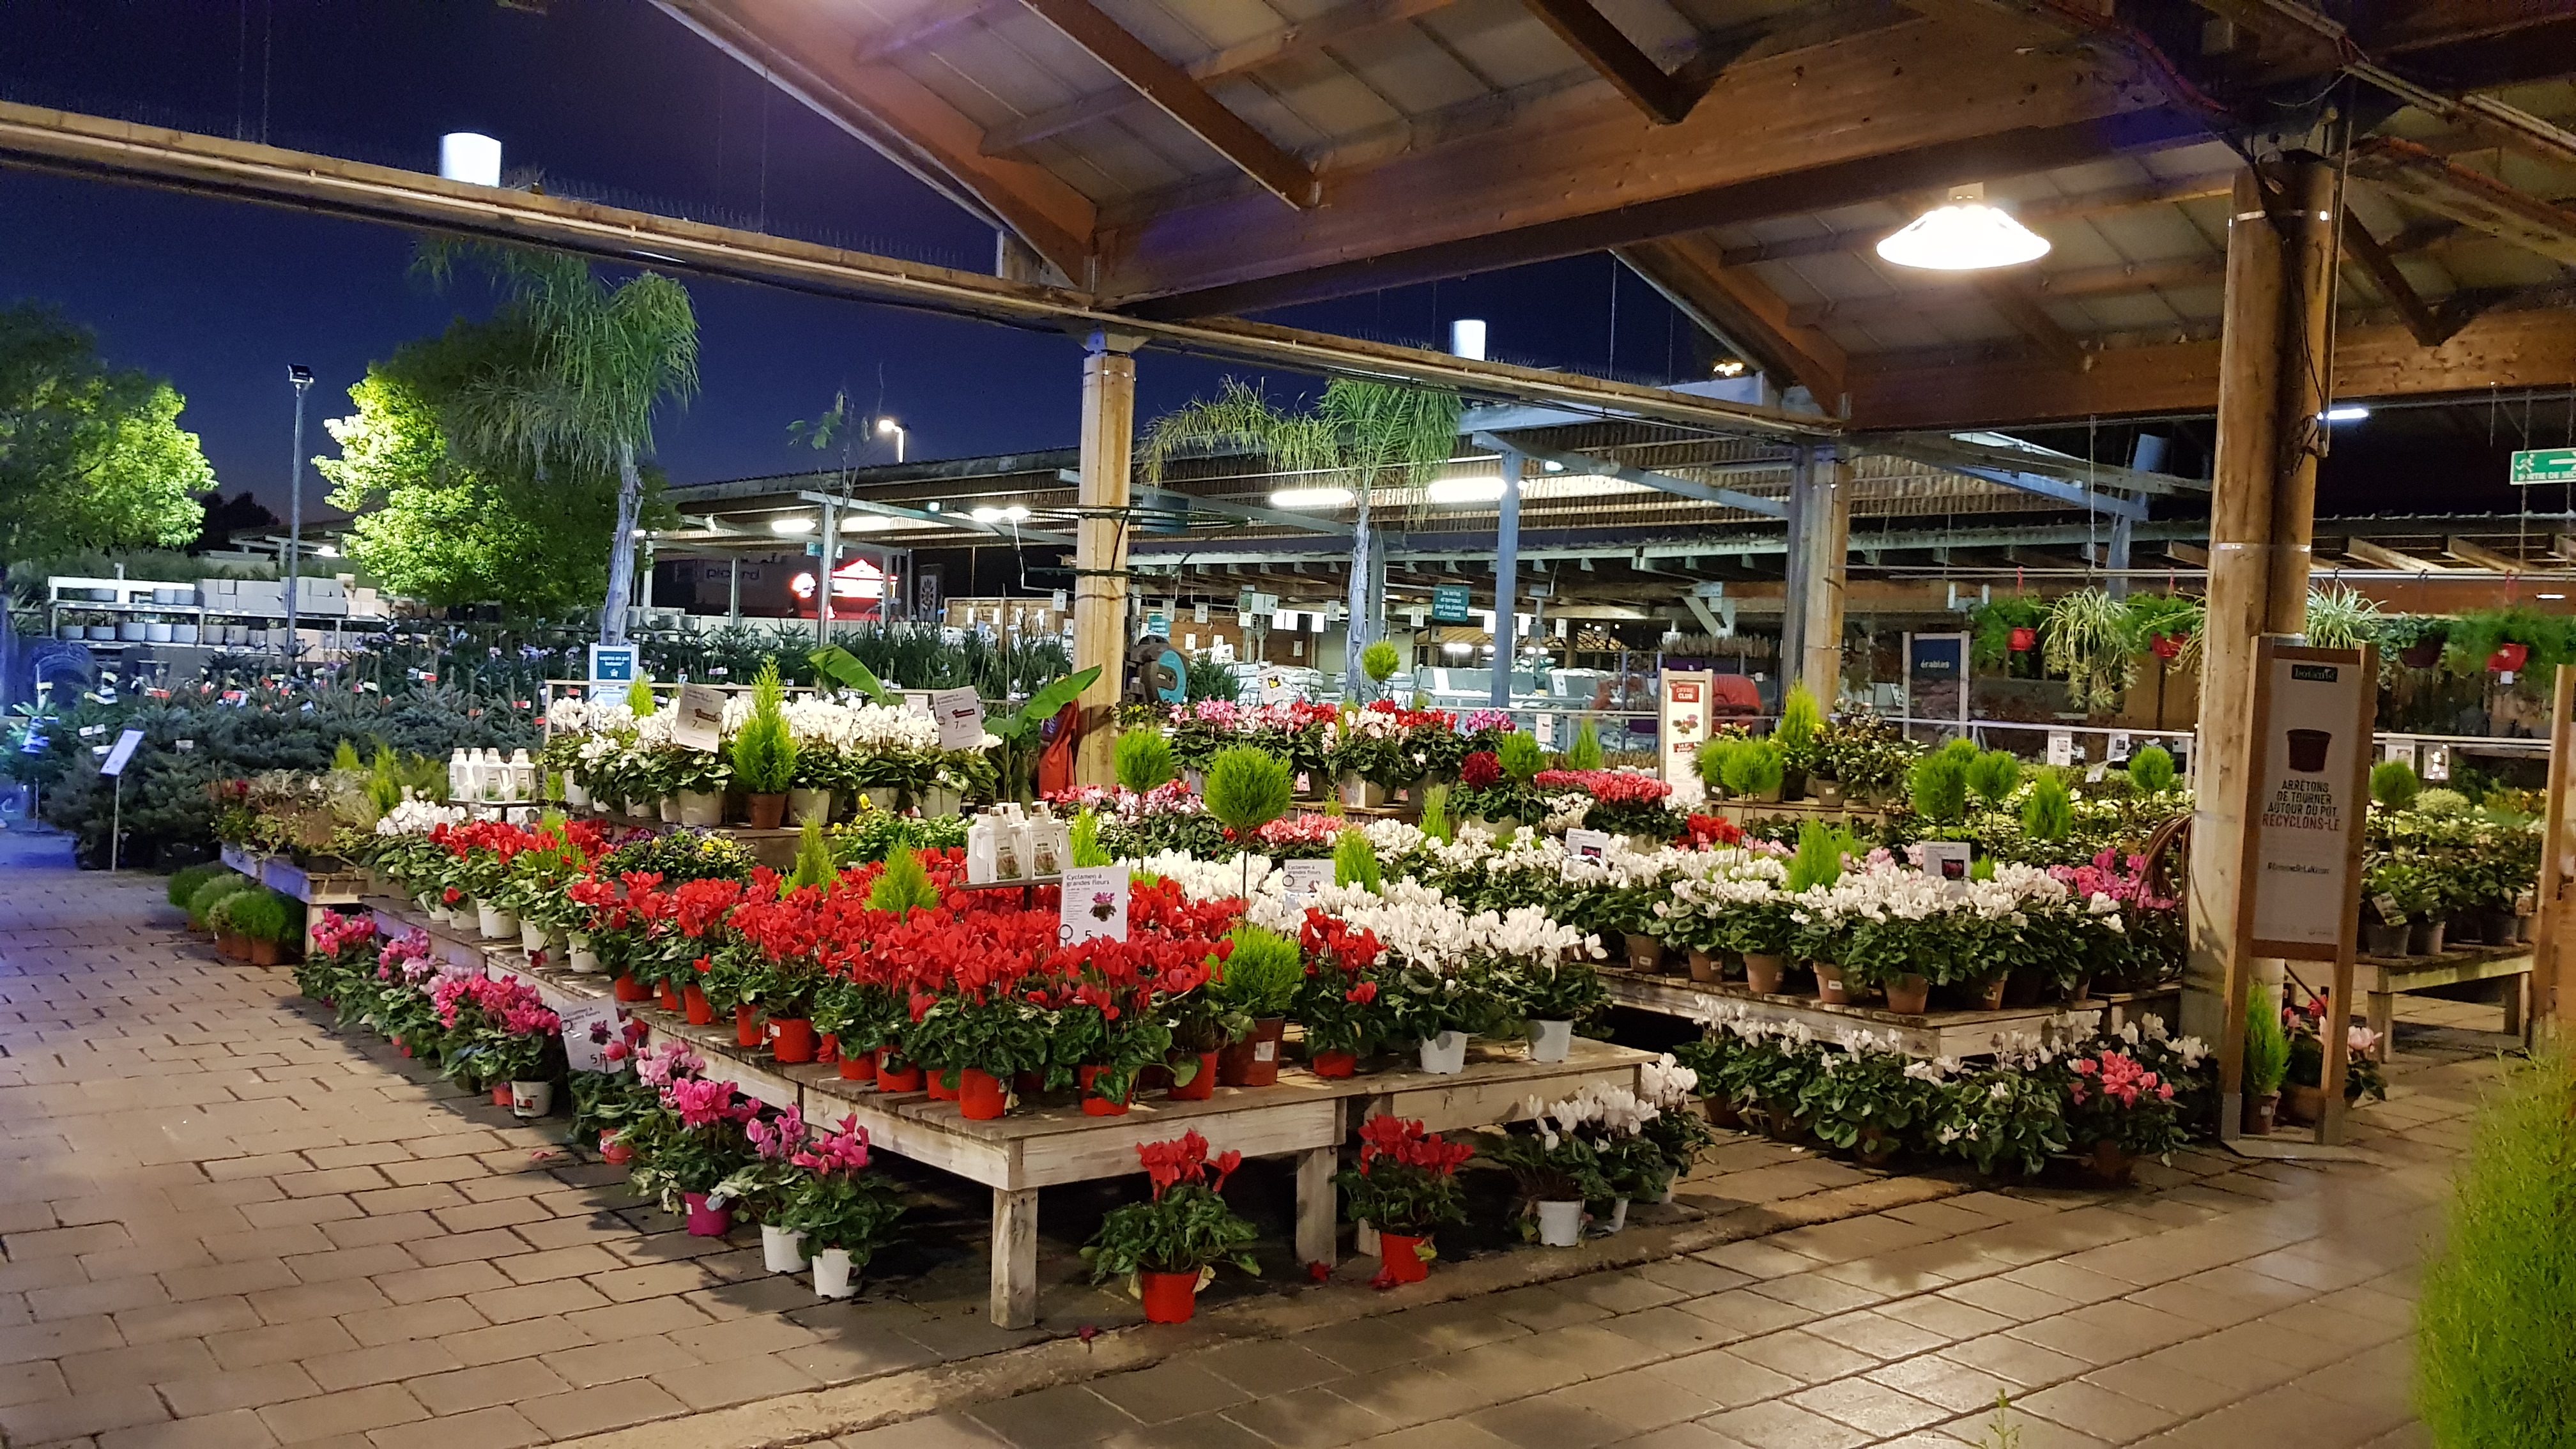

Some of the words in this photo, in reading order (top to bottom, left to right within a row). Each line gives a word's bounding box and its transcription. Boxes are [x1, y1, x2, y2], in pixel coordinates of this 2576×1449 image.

[1920, 659, 1949, 668] érables
[2276, 791, 2288, 802] DE
[2291, 792, 2332, 805] TOURNER
[2268, 802, 2303, 815] AUTOUR
[2306, 804, 2318, 815] DU
[590, 1054, 597, 1064] 5
